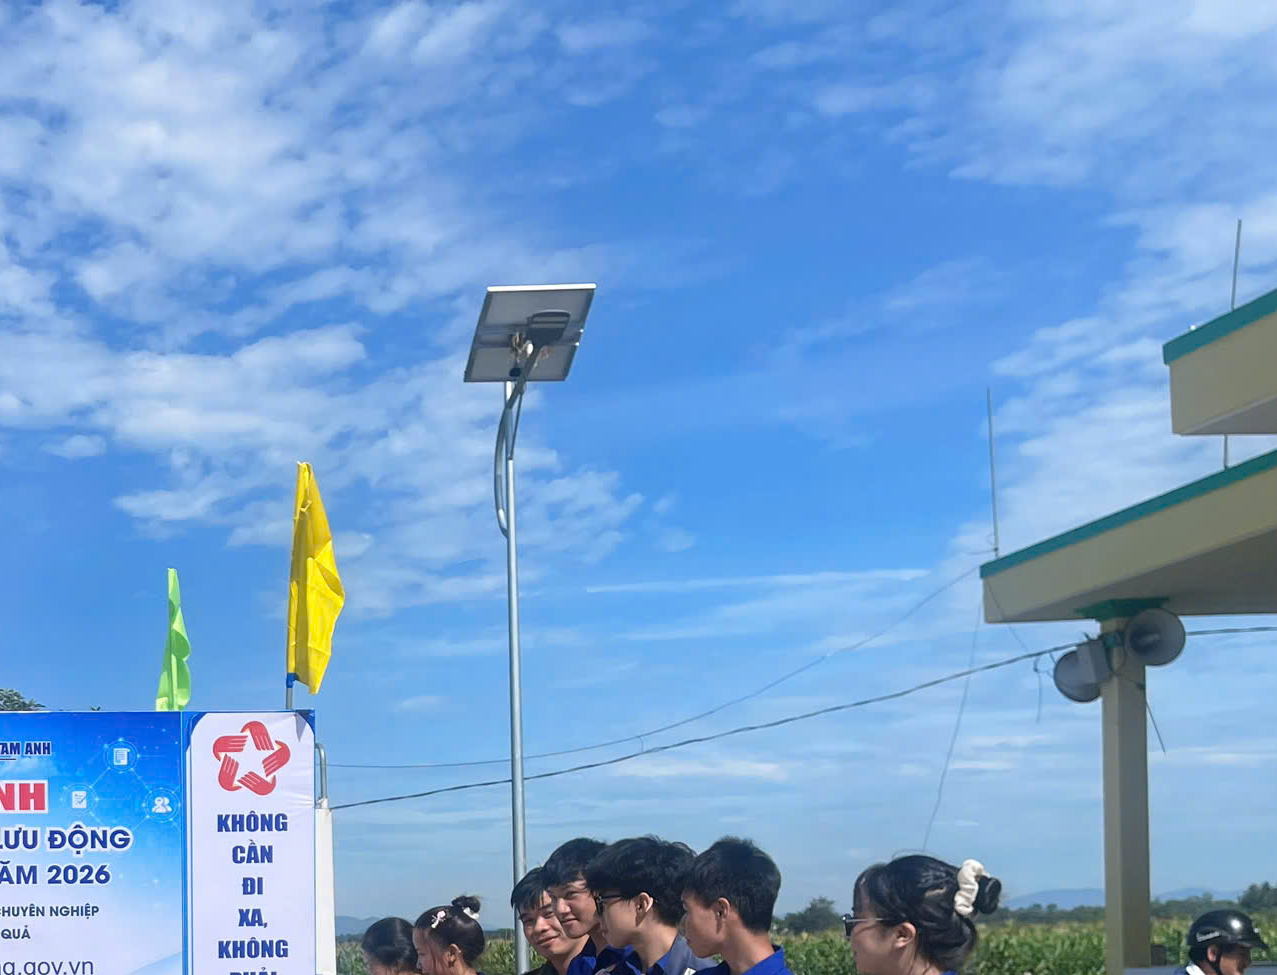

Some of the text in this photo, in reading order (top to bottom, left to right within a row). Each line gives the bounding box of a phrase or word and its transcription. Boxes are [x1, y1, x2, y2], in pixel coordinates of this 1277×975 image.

[24, 742, 51, 755] ANH
[218, 811, 287, 832] KHÔNG
[48, 824, 131, 855] ĐỘNG
[232, 840, 272, 864] CẦN
[48, 865, 110, 884] 2026
[242, 877, 263, 895] ĐI
[50, 903, 99, 919] NGHIỆP
[239, 909, 267, 928] XA,
[1, 925, 30, 939] QUẢ
[219, 937, 288, 958] KHÔNG
